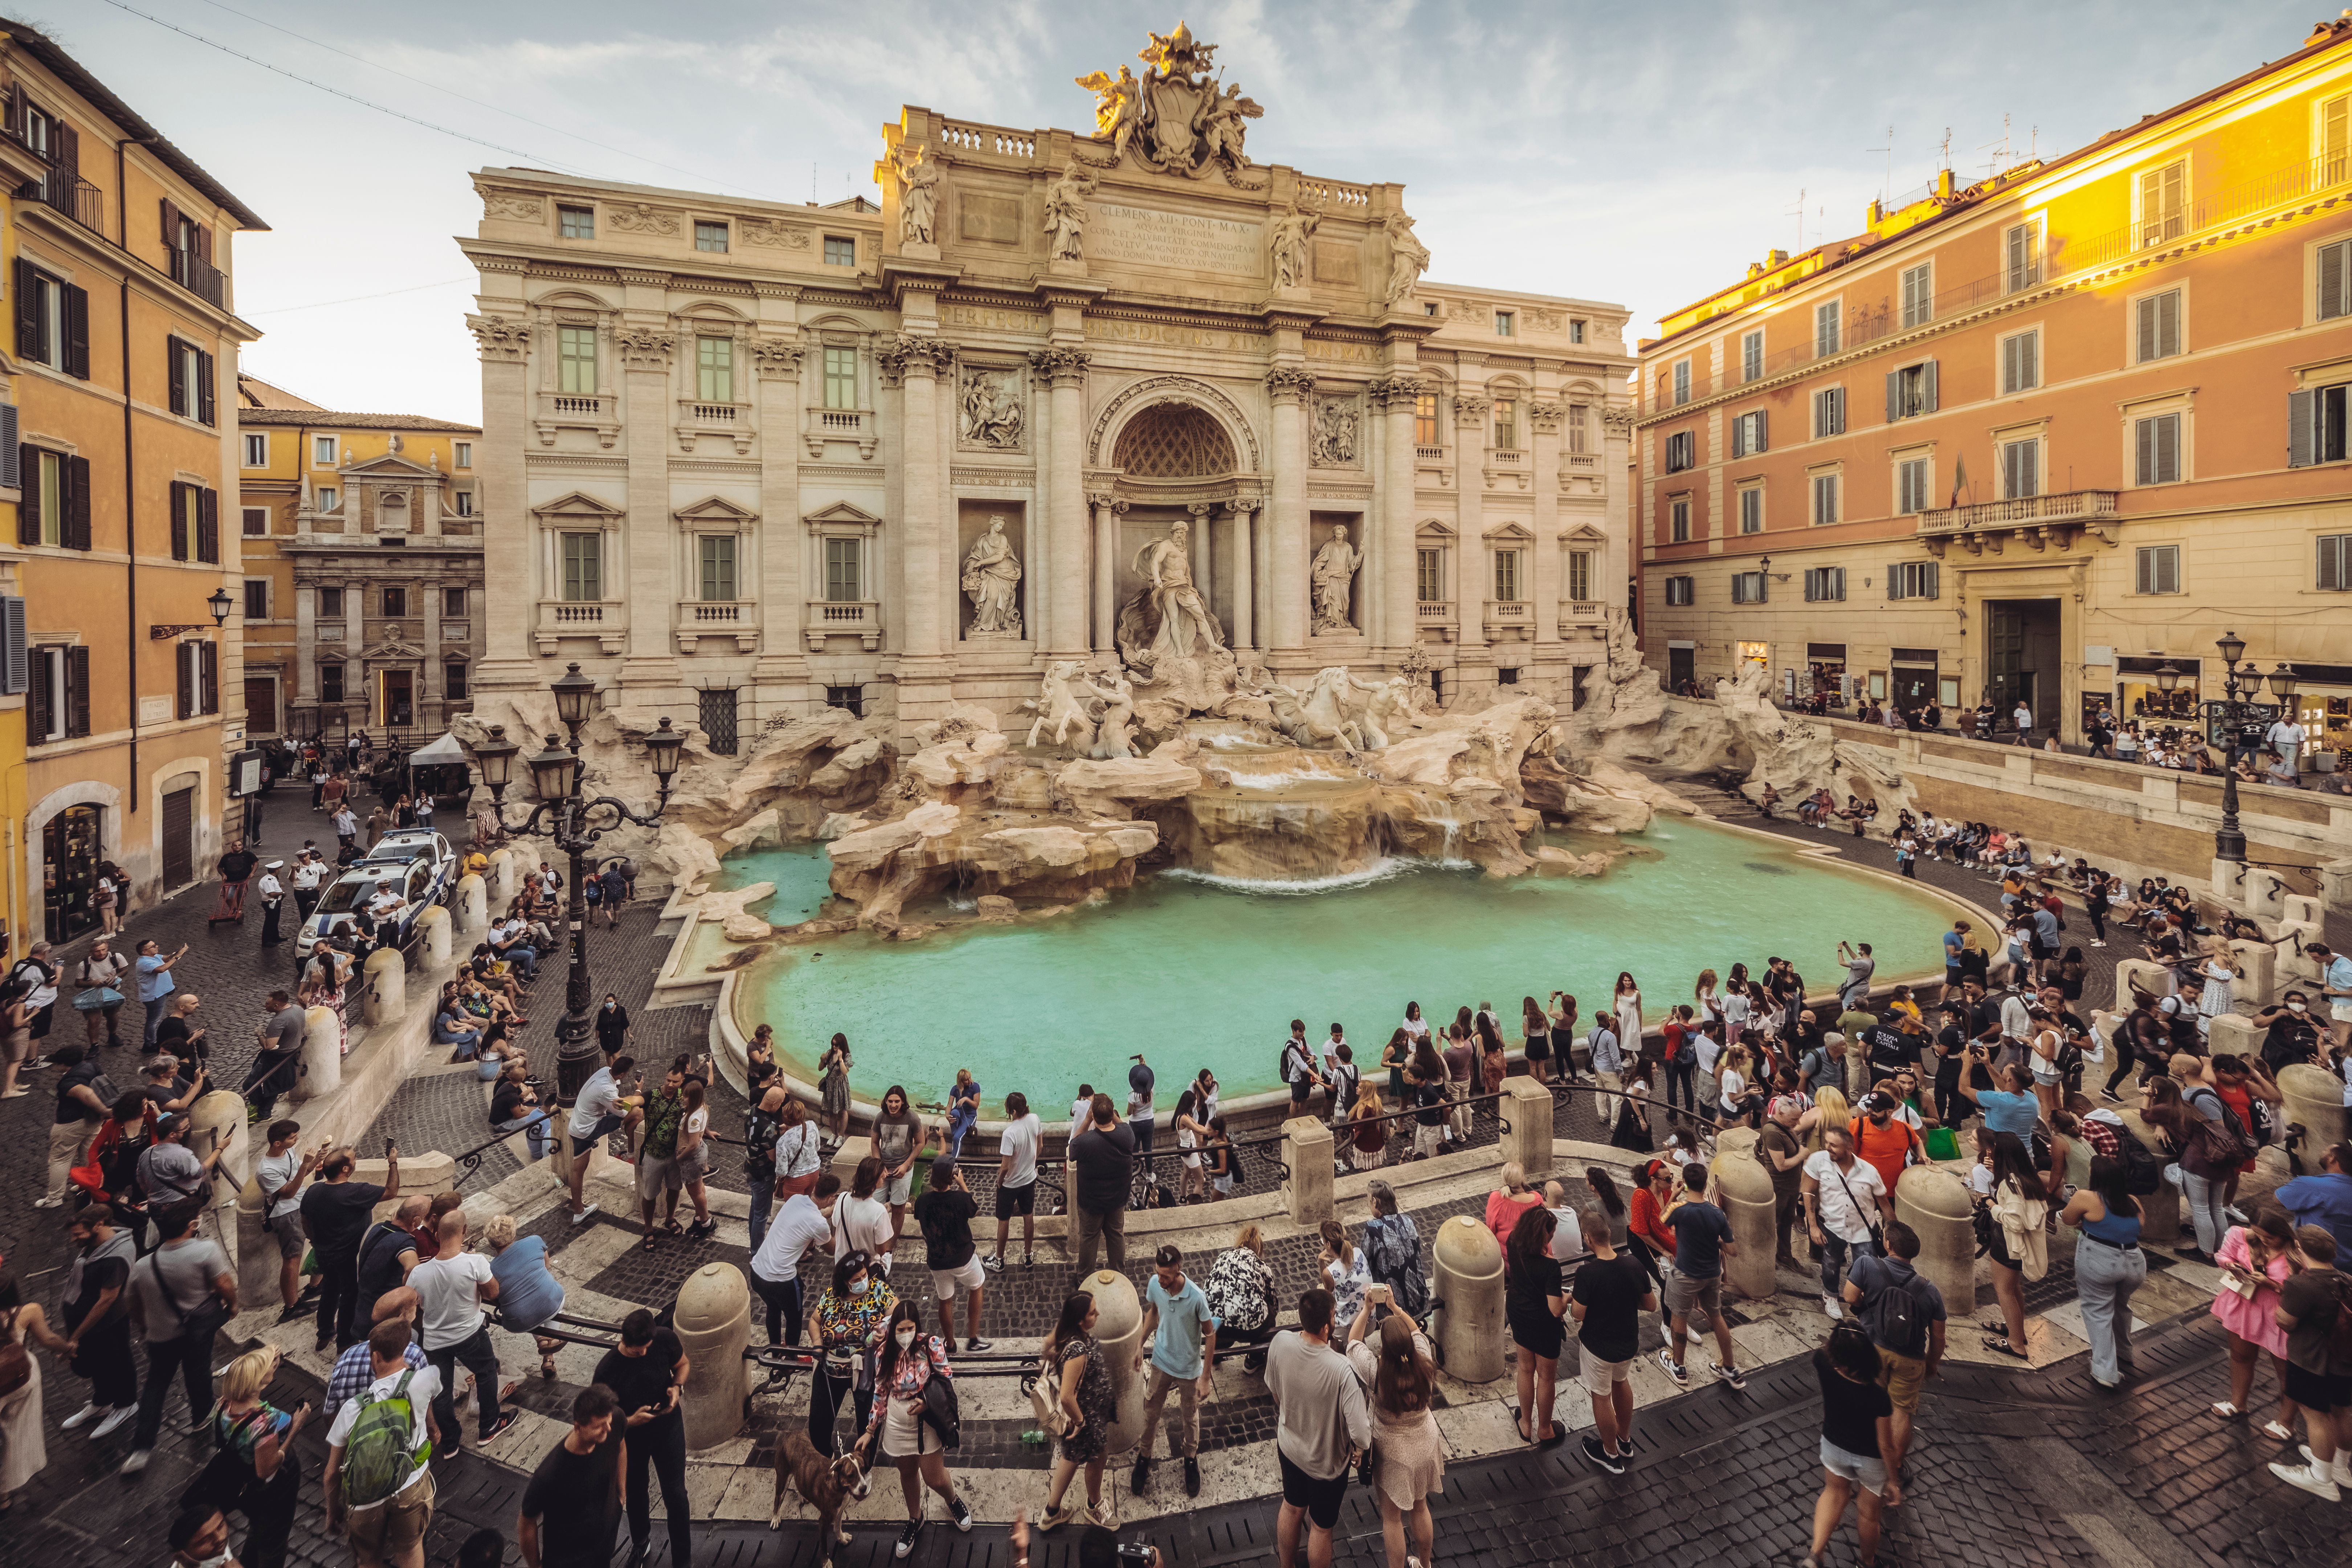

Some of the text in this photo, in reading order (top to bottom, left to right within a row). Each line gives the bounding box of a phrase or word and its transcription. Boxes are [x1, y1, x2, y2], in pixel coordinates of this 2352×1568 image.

[1100, 206, 1151, 221] CLEMENS
[1135, 223, 1214, 239] AQVAM VIRGINEM
[1090, 227, 1116, 236] COPIA
[1133, 232, 1187, 245] SALVBRITATE
[1191, 240, 1255, 254] COMMENDATAM
[1094, 247, 1120, 256] ANNO
[1124, 250, 1155, 261] DOMINI
[1112, 240, 1236, 261] CVLTV MAGNIFICO ORNAVIT
[942, 307, 1043, 331] PERFECIT
[1087, 318, 1213, 346] BENEDICTVS
[1877, 1031, 1898, 1042] POLIZIA
[1877, 1035, 1892, 1044] ROMA
[1876, 1039, 1899, 1051] CAPITALE
